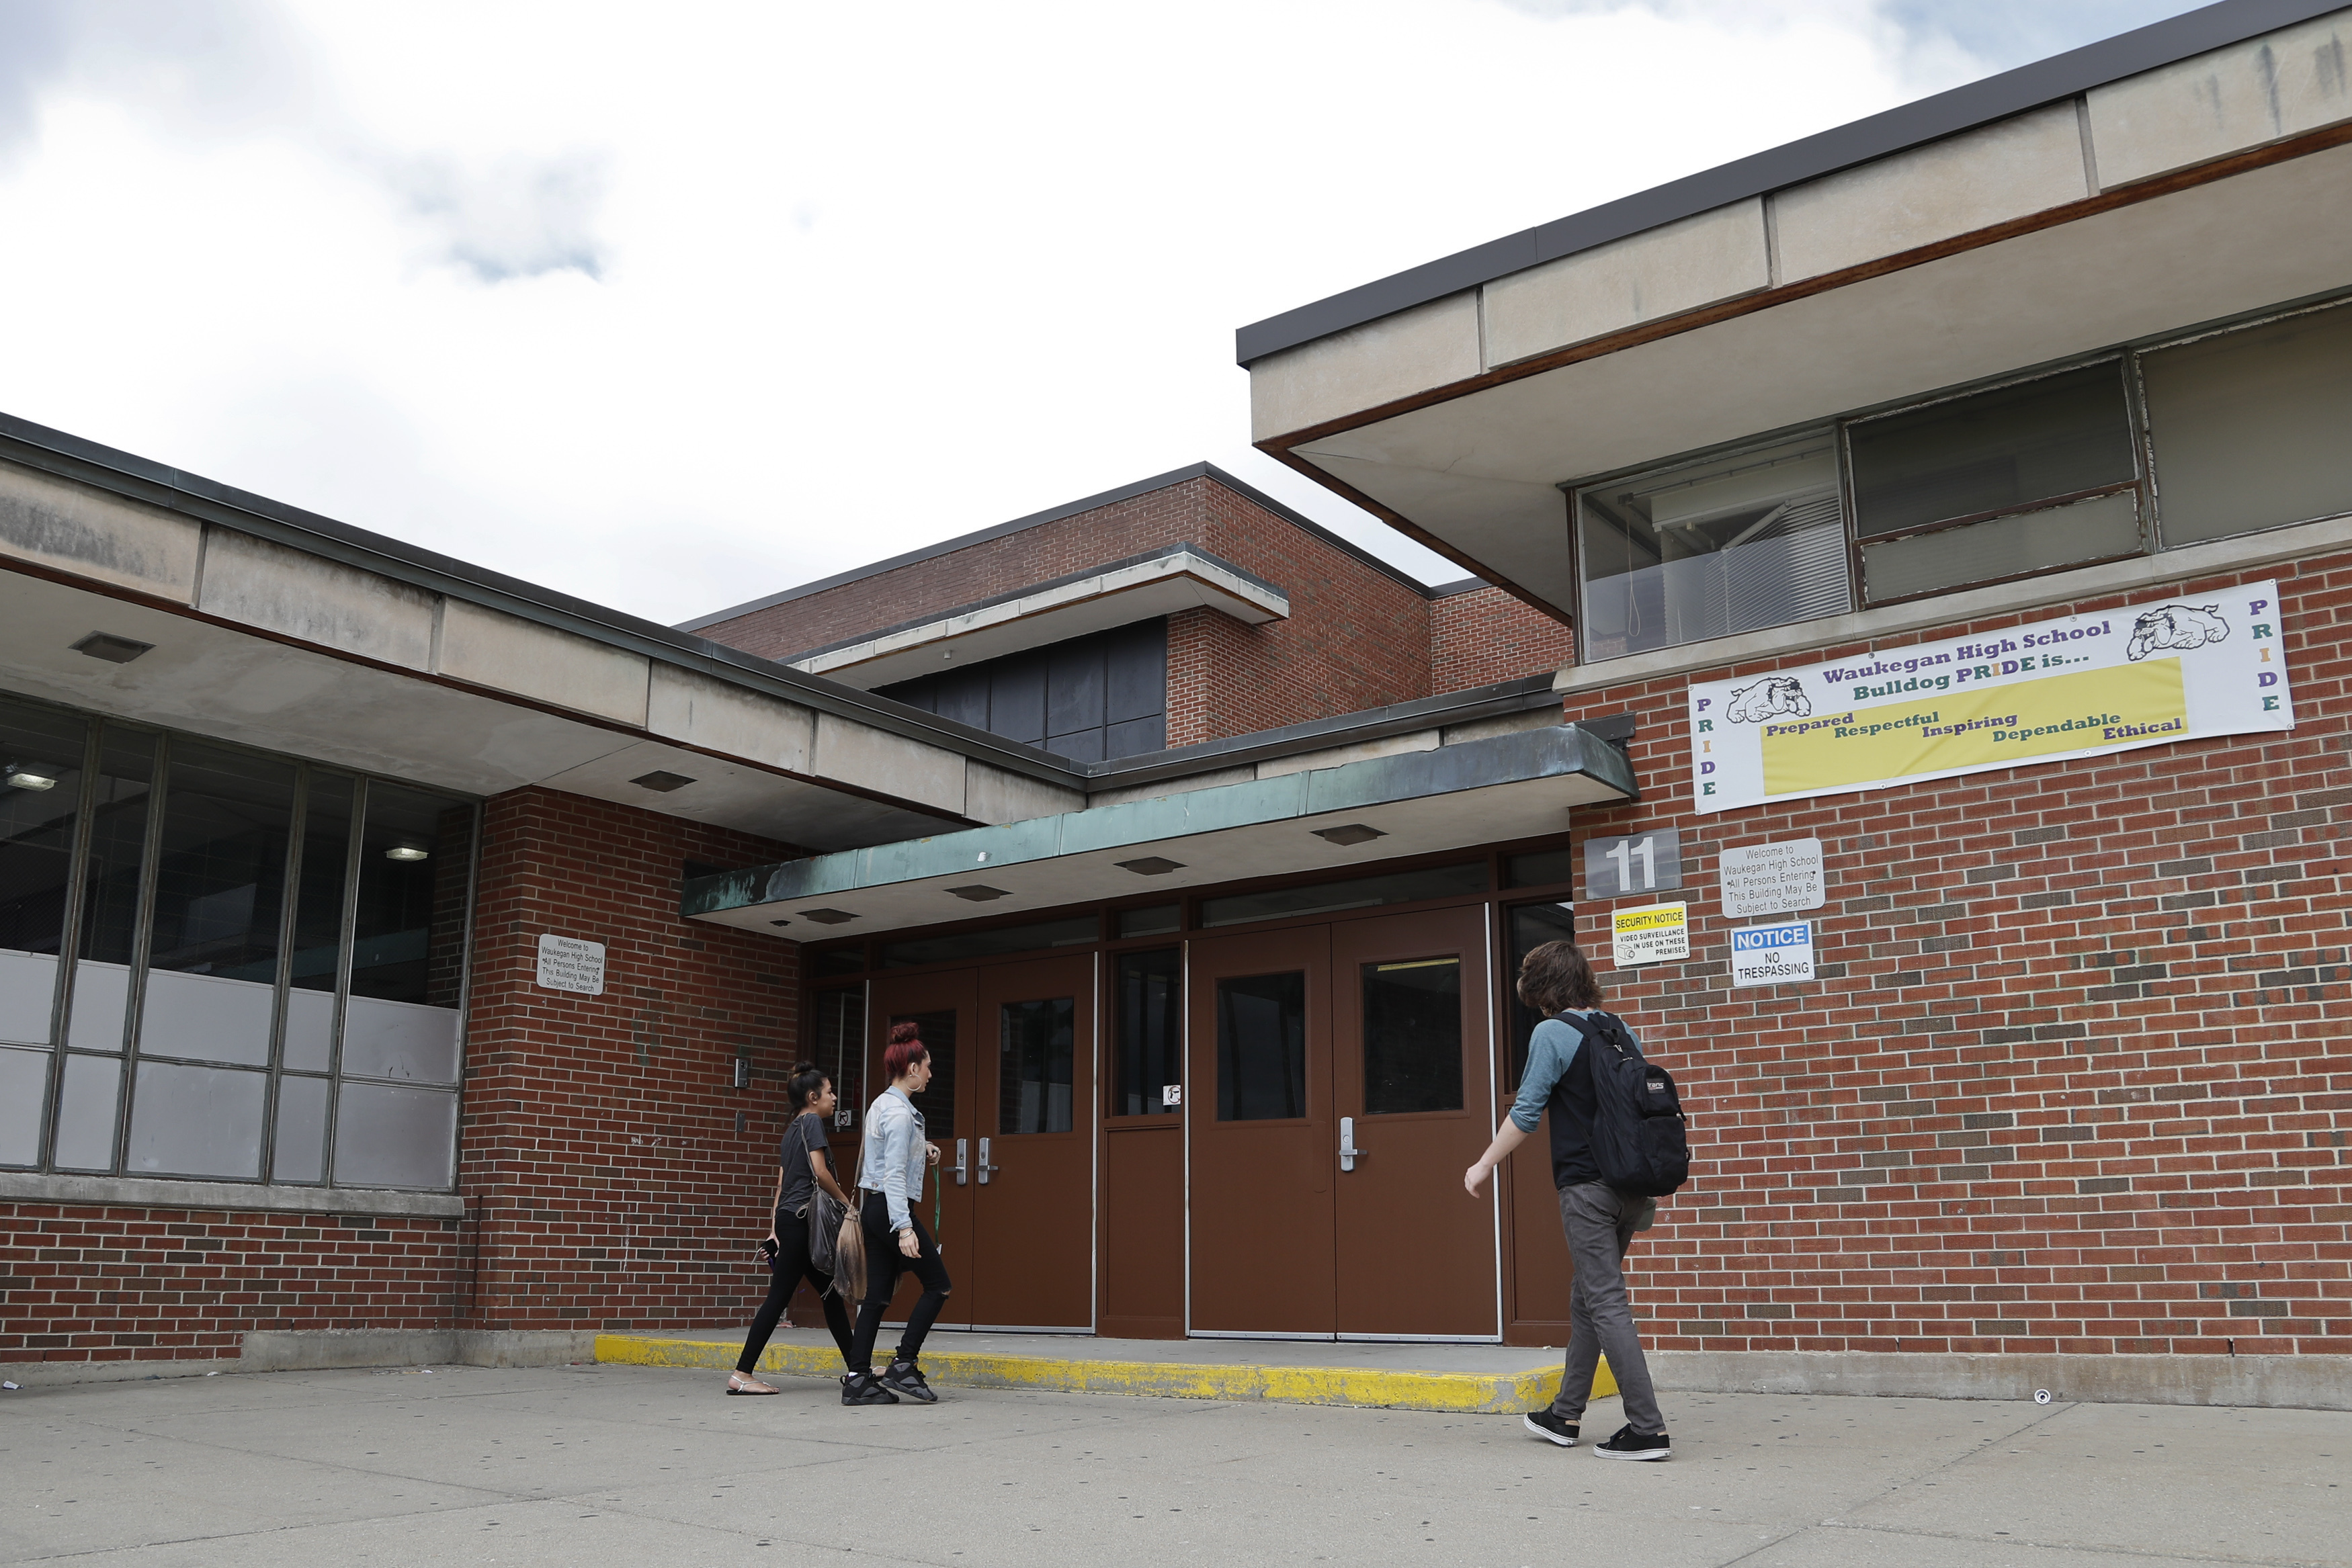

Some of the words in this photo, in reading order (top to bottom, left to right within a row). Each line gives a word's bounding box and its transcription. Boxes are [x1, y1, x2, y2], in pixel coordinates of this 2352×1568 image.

[1823, 652, 1951, 683] Waukegan
[1957, 639, 2017, 660] High
[2023, 620, 2111, 648] School
[2249, 599, 2280, 711] PRIDE
[1853, 674, 1949, 700] Bulldog
[1956, 656, 2035, 683] PRIDE
[2042, 654, 2089, 668] is...
[1766, 713, 1855, 736] Prepared
[1834, 711, 1939, 738] Respectful
[1923, 714, 2018, 738] Inspiring
[1992, 713, 2121, 742] Dependable
[2103, 717, 2182, 740] Ethical
[1697, 699, 1716, 795] PRIDE
[1746, 848, 1783, 859] Welcome
[1786, 845, 1794, 854] to
[1605, 836, 1655, 891] 11
[1724, 863, 1766, 875] Waukegan
[1769, 859, 1788, 871] High
[1790, 855, 1818, 867] School
[1730, 879, 1740, 888] All
[1744, 875, 1776, 887] Persons
[1780, 870, 1814, 882] Entering
[1728, 891, 1745, 902] This
[1749, 887, 1781, 899] Building
[1785, 885, 1802, 896] May
[1806, 882, 1817, 892] Be
[1736, 902, 1767, 914] Subject
[1770, 901, 1778, 910] to
[1781, 896, 1810, 908] Search
[1616, 916, 1652, 928] SECURITY
[1654, 912, 1683, 924] NOTICE
[1640, 928, 1684, 939] SURVEILLANCE
[1665, 937, 1685, 945] THESE
[1737, 928, 1805, 949] NOTICE
[558, 939, 582, 950] Welcome
[1656, 946, 1686, 955] PREMISES
[542, 947, 569, 959] Waukegan
[571, 951, 583, 961] High
[585, 954, 602, 963] School
[1765, 952, 1779, 963] NO
[542, 967, 554, 975] This
[556, 969, 577, 981] Building
[579, 973, 590, 984] May
[553, 959, 575, 969] Persons
[577, 963, 599, 975] Entering
[1738, 962, 1809, 979] TRESPASSING
[546, 977, 566, 988] Subject
[575, 982, 594, 992] Search
